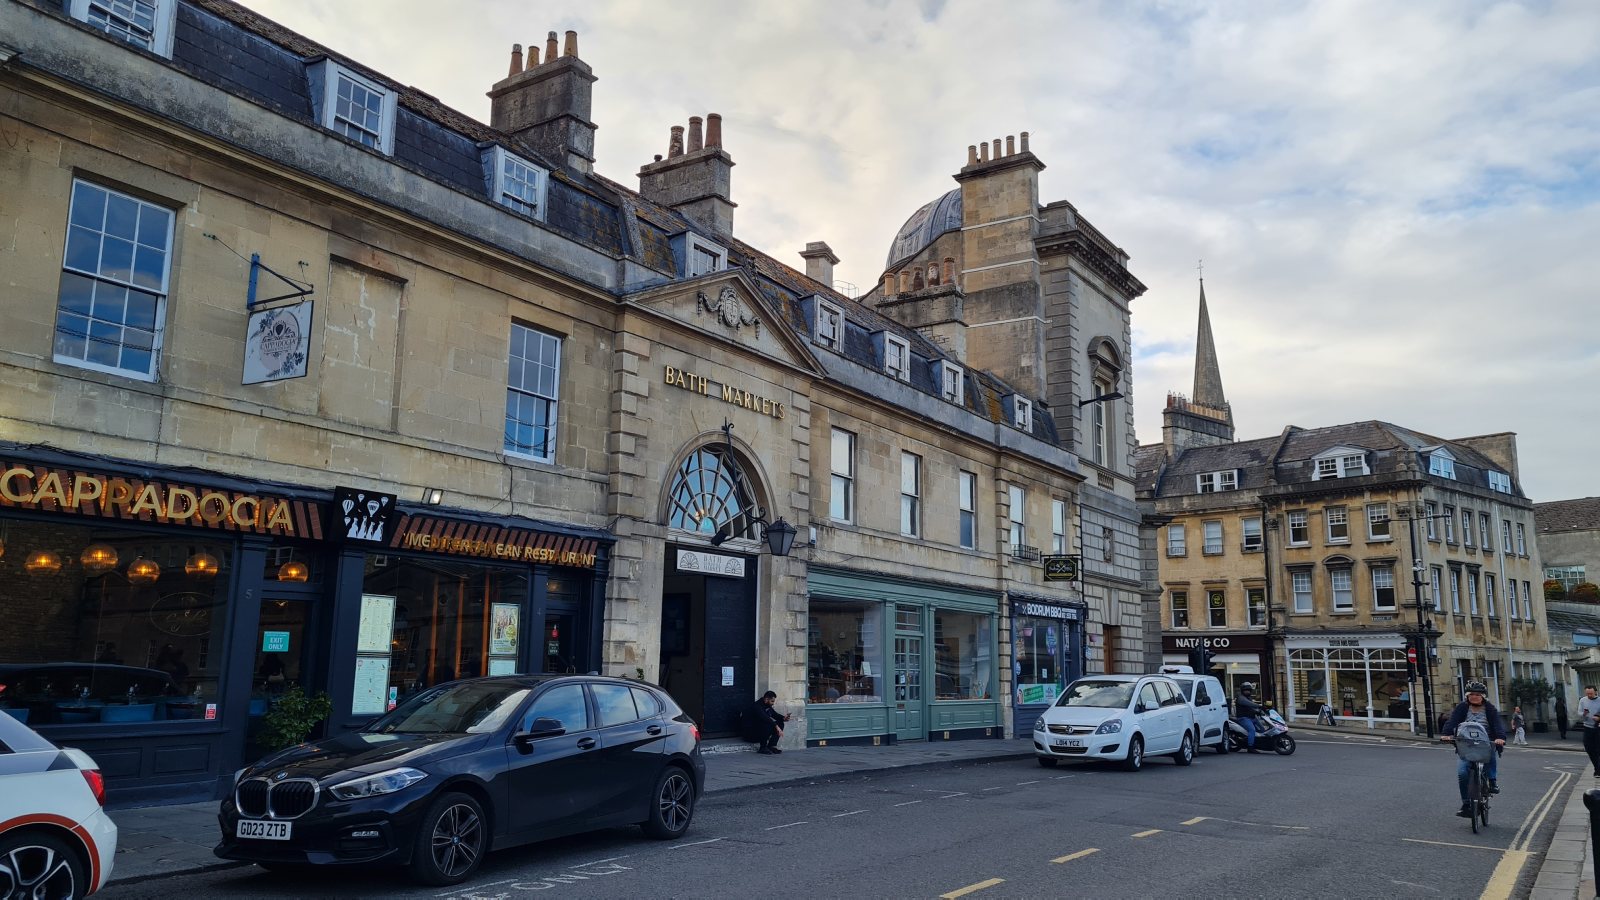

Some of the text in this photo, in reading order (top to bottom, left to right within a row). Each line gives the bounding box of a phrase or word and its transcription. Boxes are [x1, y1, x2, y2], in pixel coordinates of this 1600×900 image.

[665, 365, 786, 419] BATH MARKETS
[0, 468, 294, 531] CAPPADOCIA
[1051, 606, 1062, 618] BBQ
[1203, 638, 1211, 647] &
[1213, 638, 1230, 647] CO
[240, 822, 287, 837] GD23 ZTB
